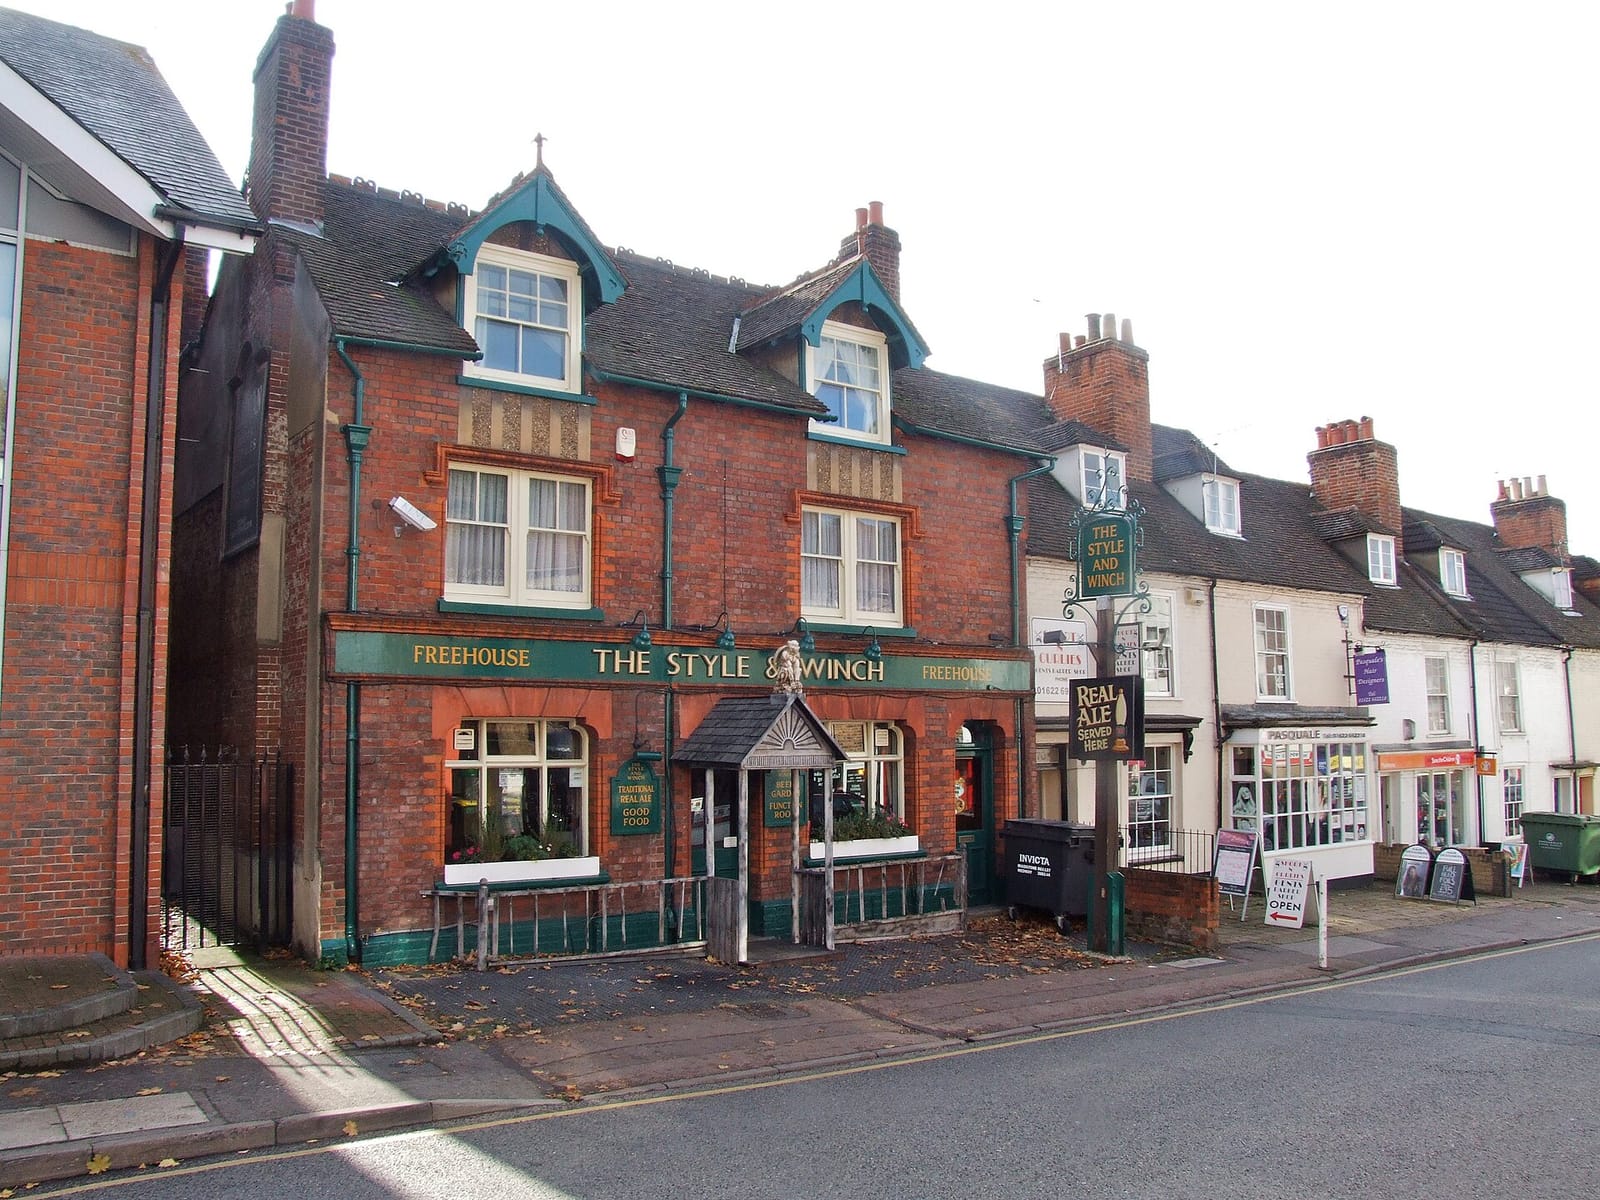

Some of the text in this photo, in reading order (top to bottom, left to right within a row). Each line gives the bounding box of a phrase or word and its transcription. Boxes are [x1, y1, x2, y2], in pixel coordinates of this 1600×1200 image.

[1092, 525, 1117, 539] THE
[1087, 540, 1124, 556] STYLE
[1092, 557, 1119, 571] AND
[1087, 572, 1125, 588] WINCH
[414, 645, 530, 667] FREEHOUSE
[592, 649, 651, 674] THE
[667, 652, 750, 678] STYLE
[799, 658, 884, 681] WINCH
[922, 665, 993, 682] FREEHOUSE
[1077, 684, 1118, 707] REAL
[1077, 705, 1112, 727] ALE
[1078, 726, 1112, 741] SERVED
[1268, 730, 1320, 740] PASQUALE
[1084, 738, 1109, 752] HERE
[618, 785, 655, 793] TRADITIONAL
[620, 795, 652, 803] REAL ALE
[623, 807, 650, 817] GOOD
[774, 811, 792, 819] ROO
[623, 818, 650, 826] FOOD
[1020, 853, 1050, 866] INVICTA
[1269, 900, 1302, 911] OPEN
